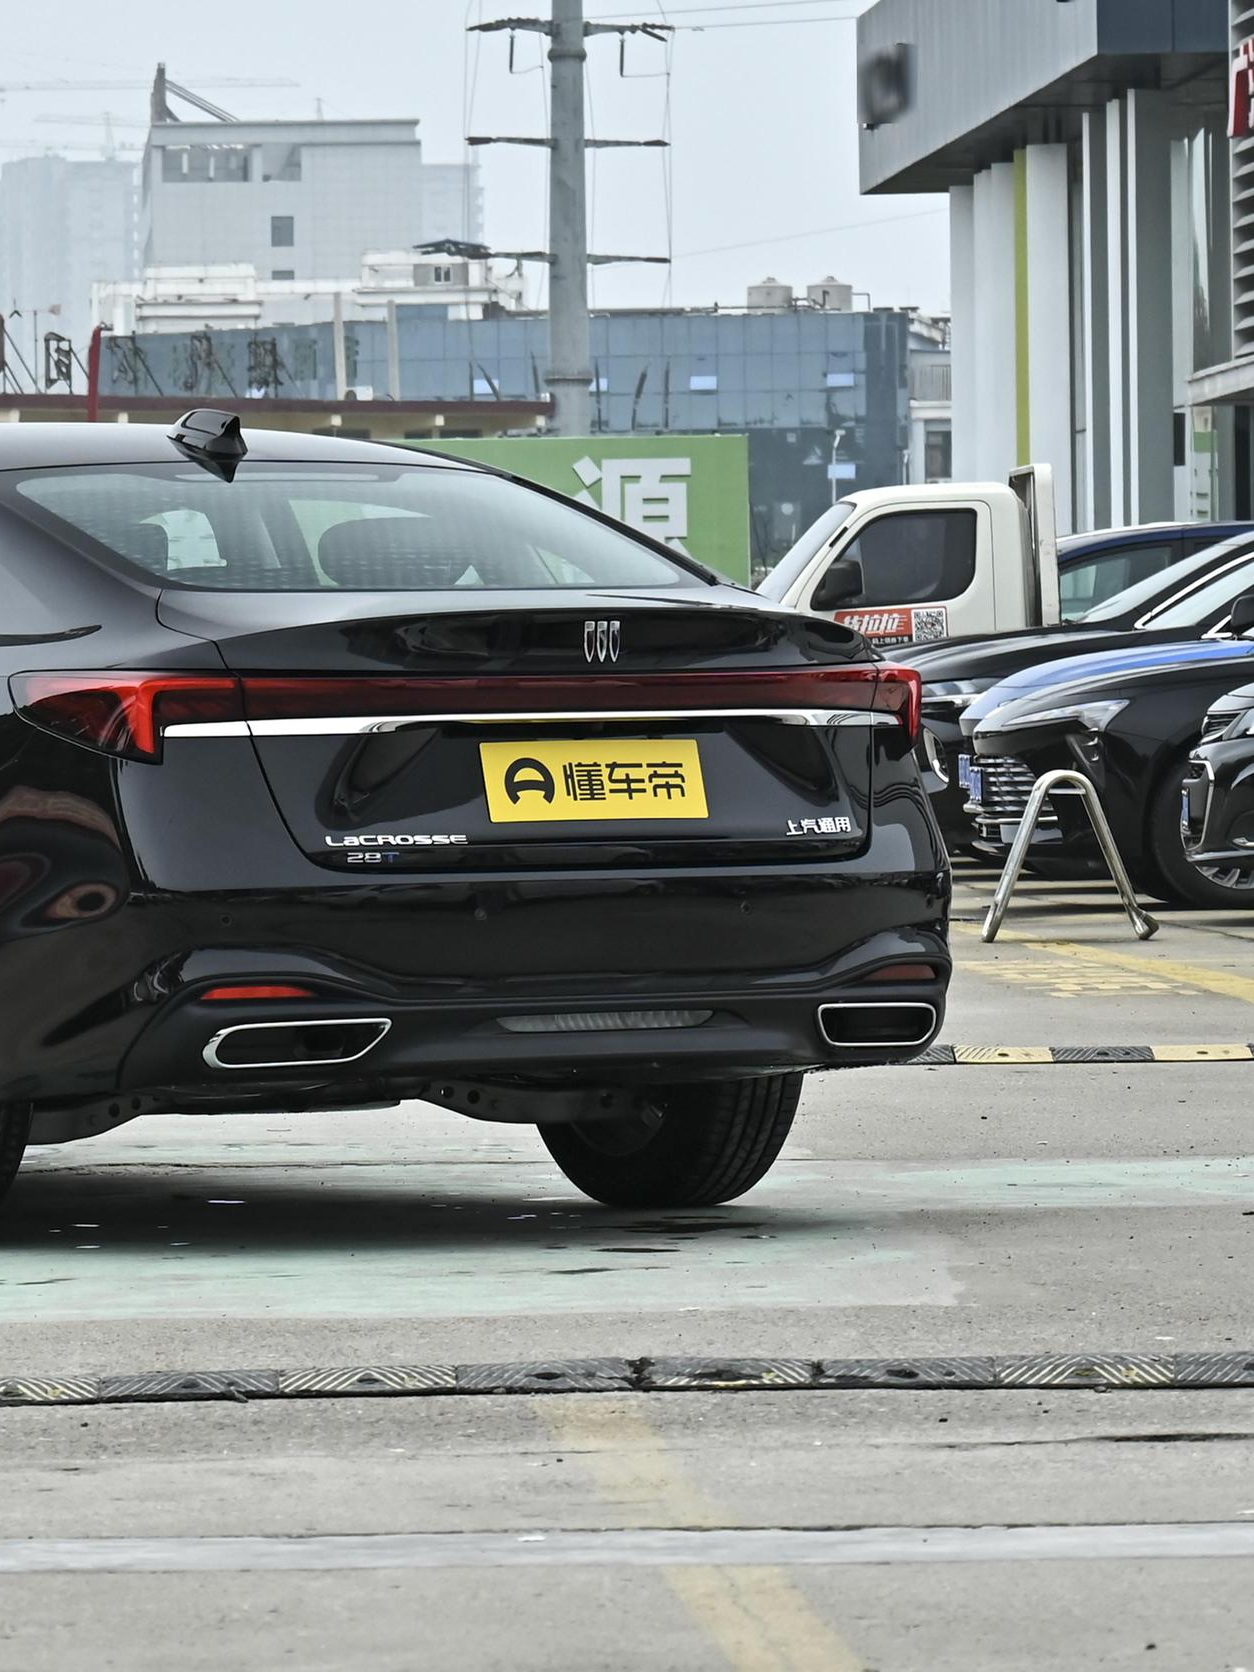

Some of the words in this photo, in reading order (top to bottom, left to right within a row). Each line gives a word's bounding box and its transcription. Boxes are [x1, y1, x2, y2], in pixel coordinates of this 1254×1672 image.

[562, 761, 686, 801] 懂车帝
[786, 816, 852, 836] 上汽通用
[347, 852, 400, 864] 28T
